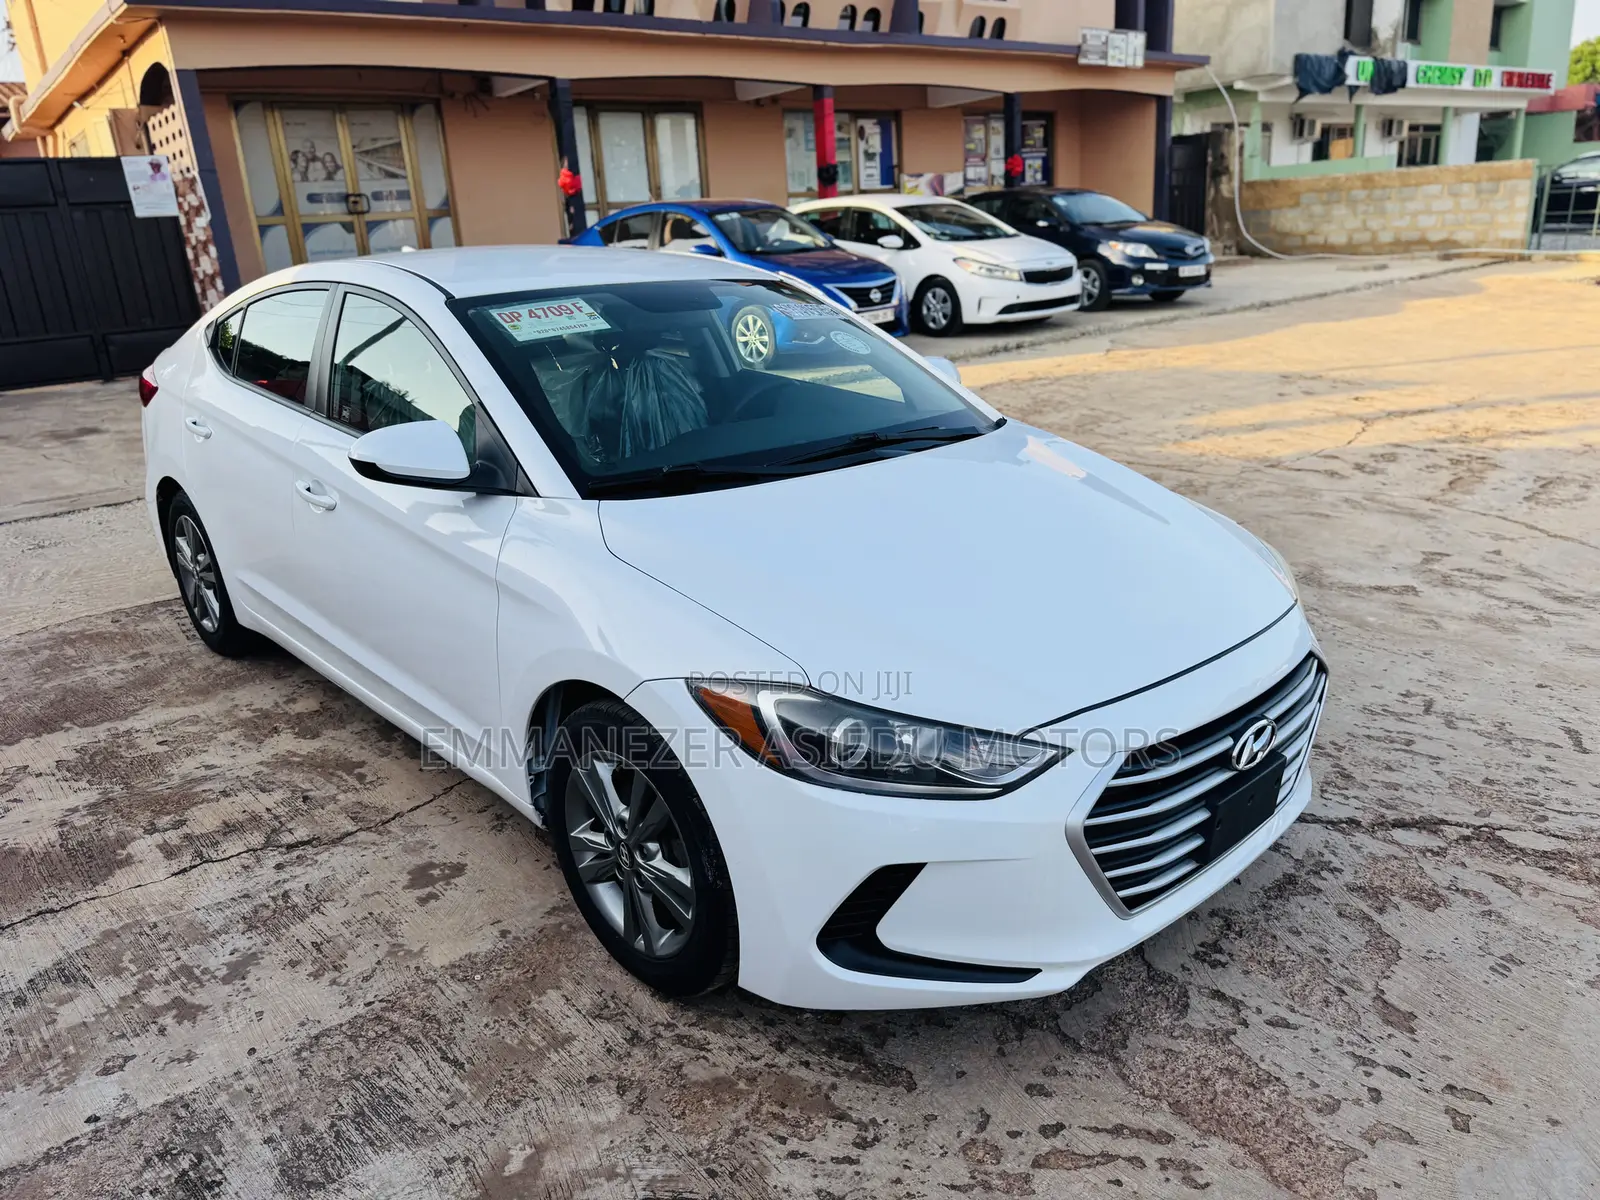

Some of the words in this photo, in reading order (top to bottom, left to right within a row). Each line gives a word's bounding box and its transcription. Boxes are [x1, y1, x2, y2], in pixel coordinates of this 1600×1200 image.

[497, 310, 522, 324] DP
[528, 304, 574, 319] 4709
[571, 301, 584, 313] F
